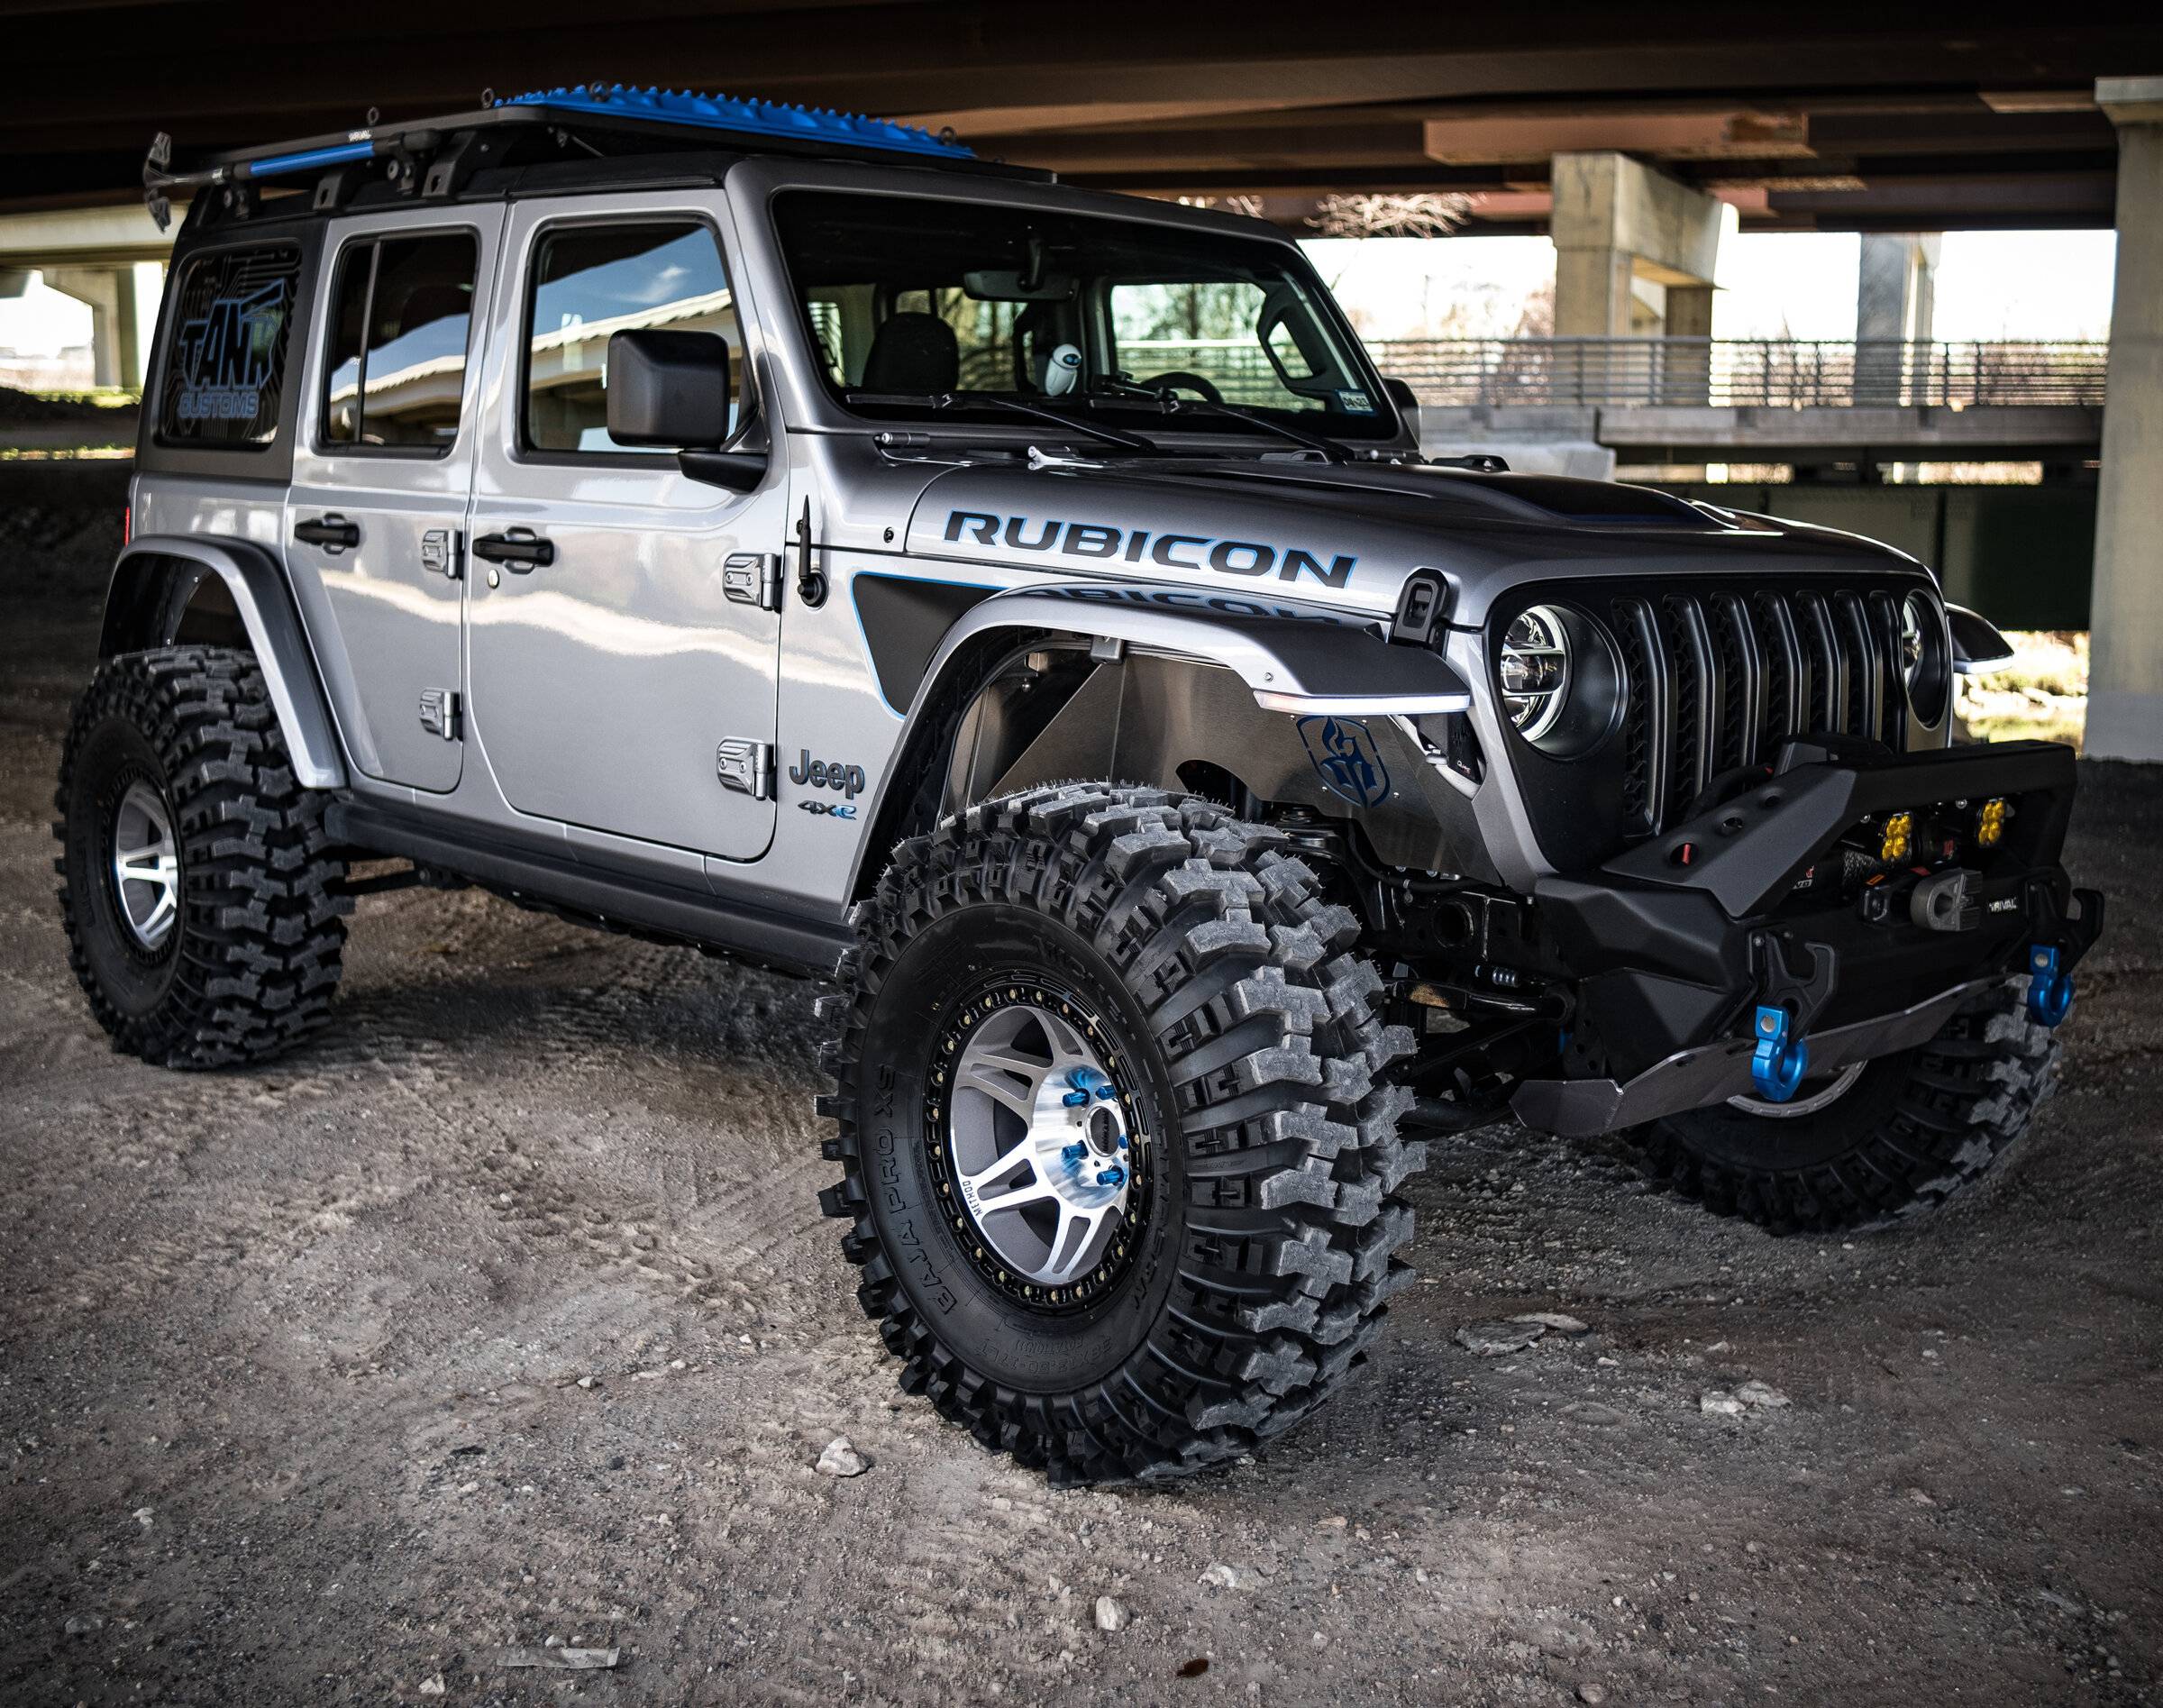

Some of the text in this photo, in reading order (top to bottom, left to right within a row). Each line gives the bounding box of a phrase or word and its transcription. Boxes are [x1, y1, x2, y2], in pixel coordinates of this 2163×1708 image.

[943, 509, 1359, 589] RUBICON
[789, 749, 865, 800] Jeep
[879, 1128, 907, 1214] PRO
[963, 1181, 983, 1216] METHOD
[901, 1219, 958, 1315] BAJA
